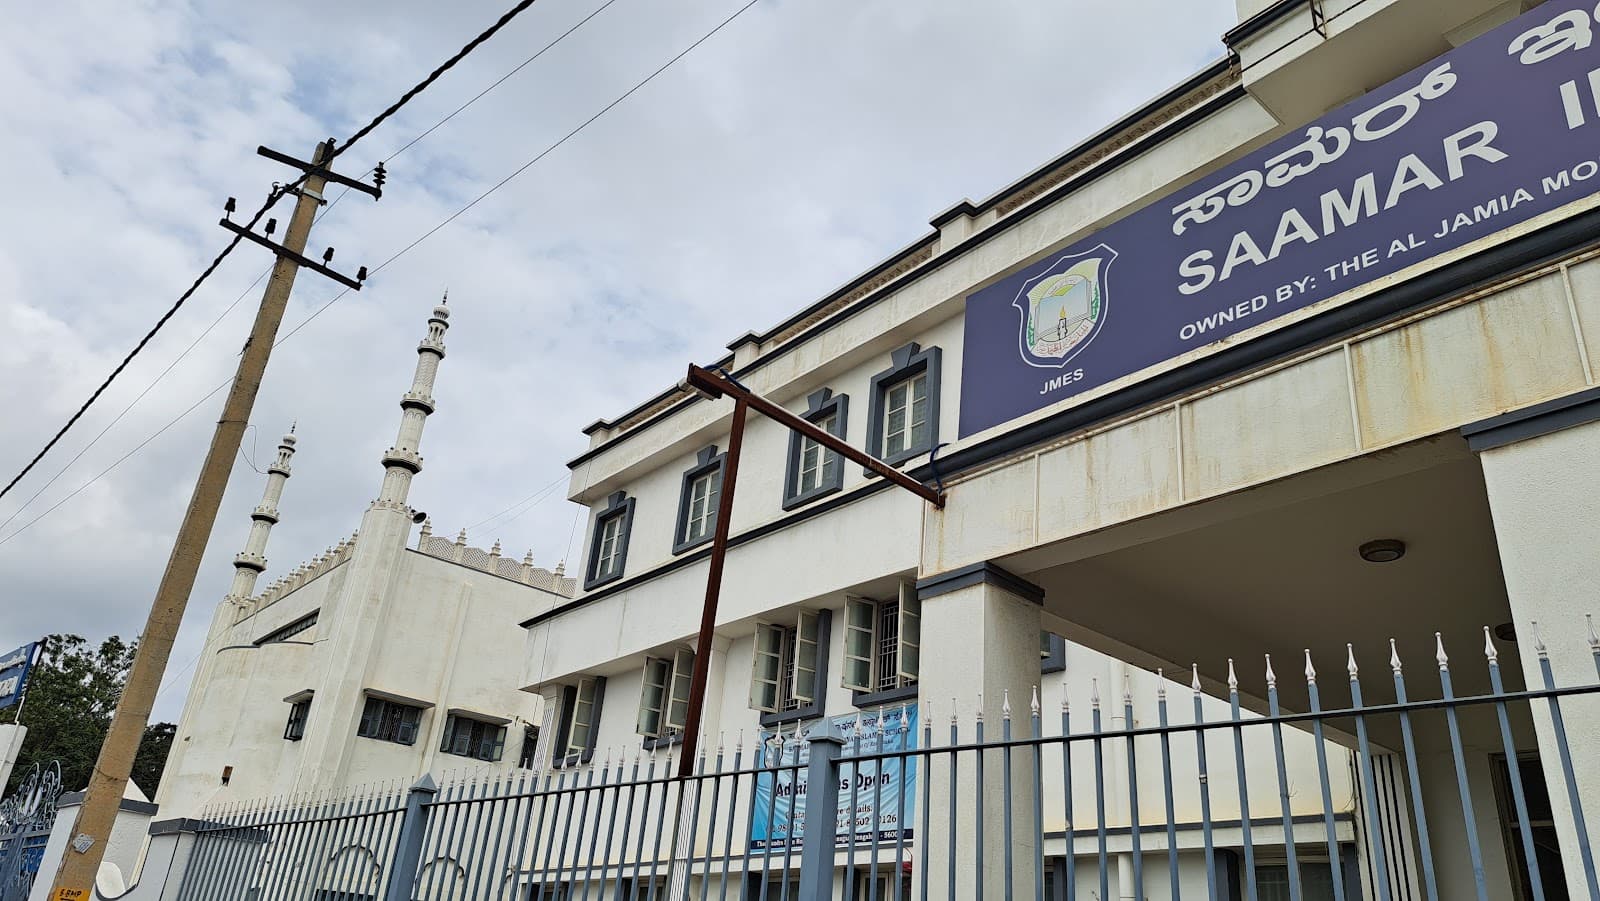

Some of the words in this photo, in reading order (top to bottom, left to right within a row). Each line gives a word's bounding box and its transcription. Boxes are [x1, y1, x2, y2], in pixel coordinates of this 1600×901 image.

[1178, 120, 1509, 295] SAAMAR
[1179, 295, 1268, 340] OWNED
[1275, 275, 1319, 303] BY:
[1324, 248, 1380, 281] THE
[1387, 233, 1426, 258] AL
[1433, 188, 1535, 239] JAMIA
[1039, 368, 1084, 395] JMES
[855, 772, 890, 791] Opn
